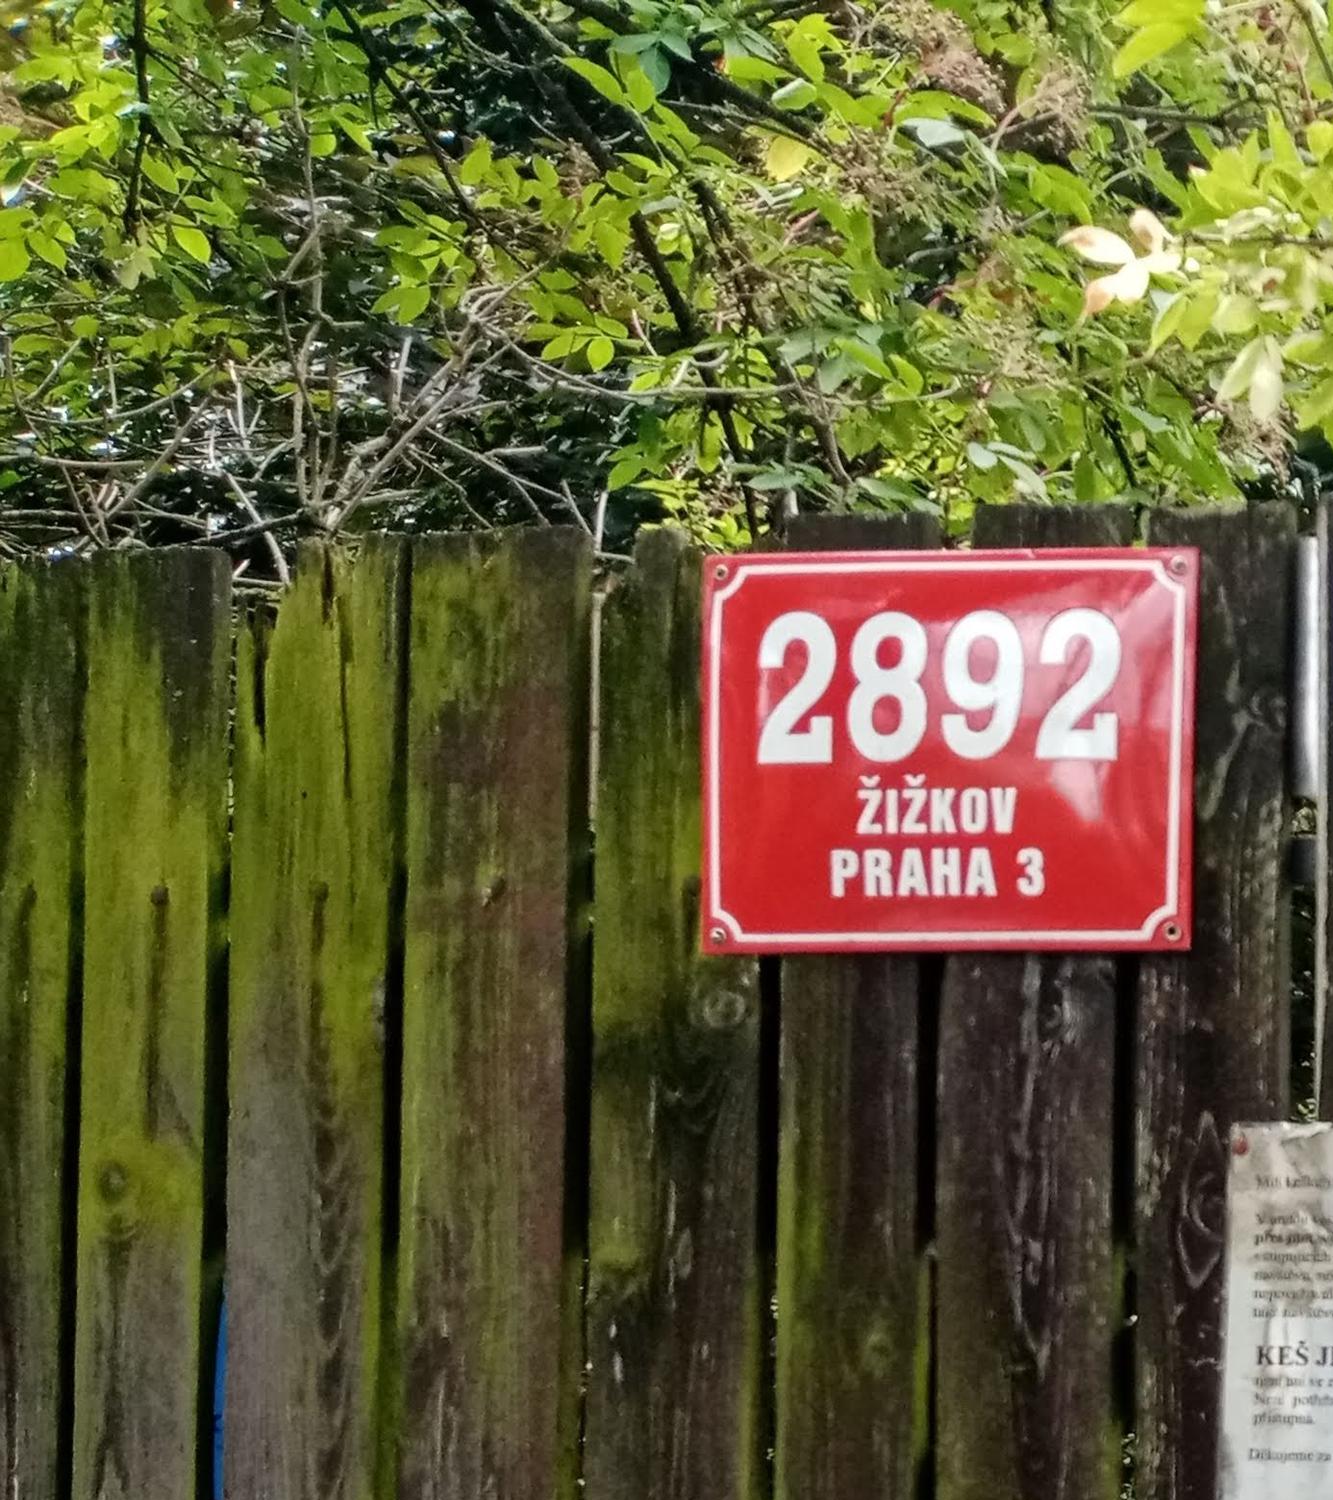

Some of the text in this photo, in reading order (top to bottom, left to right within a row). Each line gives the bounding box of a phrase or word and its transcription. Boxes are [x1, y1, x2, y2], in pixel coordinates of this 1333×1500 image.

[756, 608, 1124, 769] 2892
[856, 774, 1018, 836] ŽIŽKOV
[829, 847, 1046, 899] PRAHA 3
[1256, 1340, 1309, 1366] KEŠ
